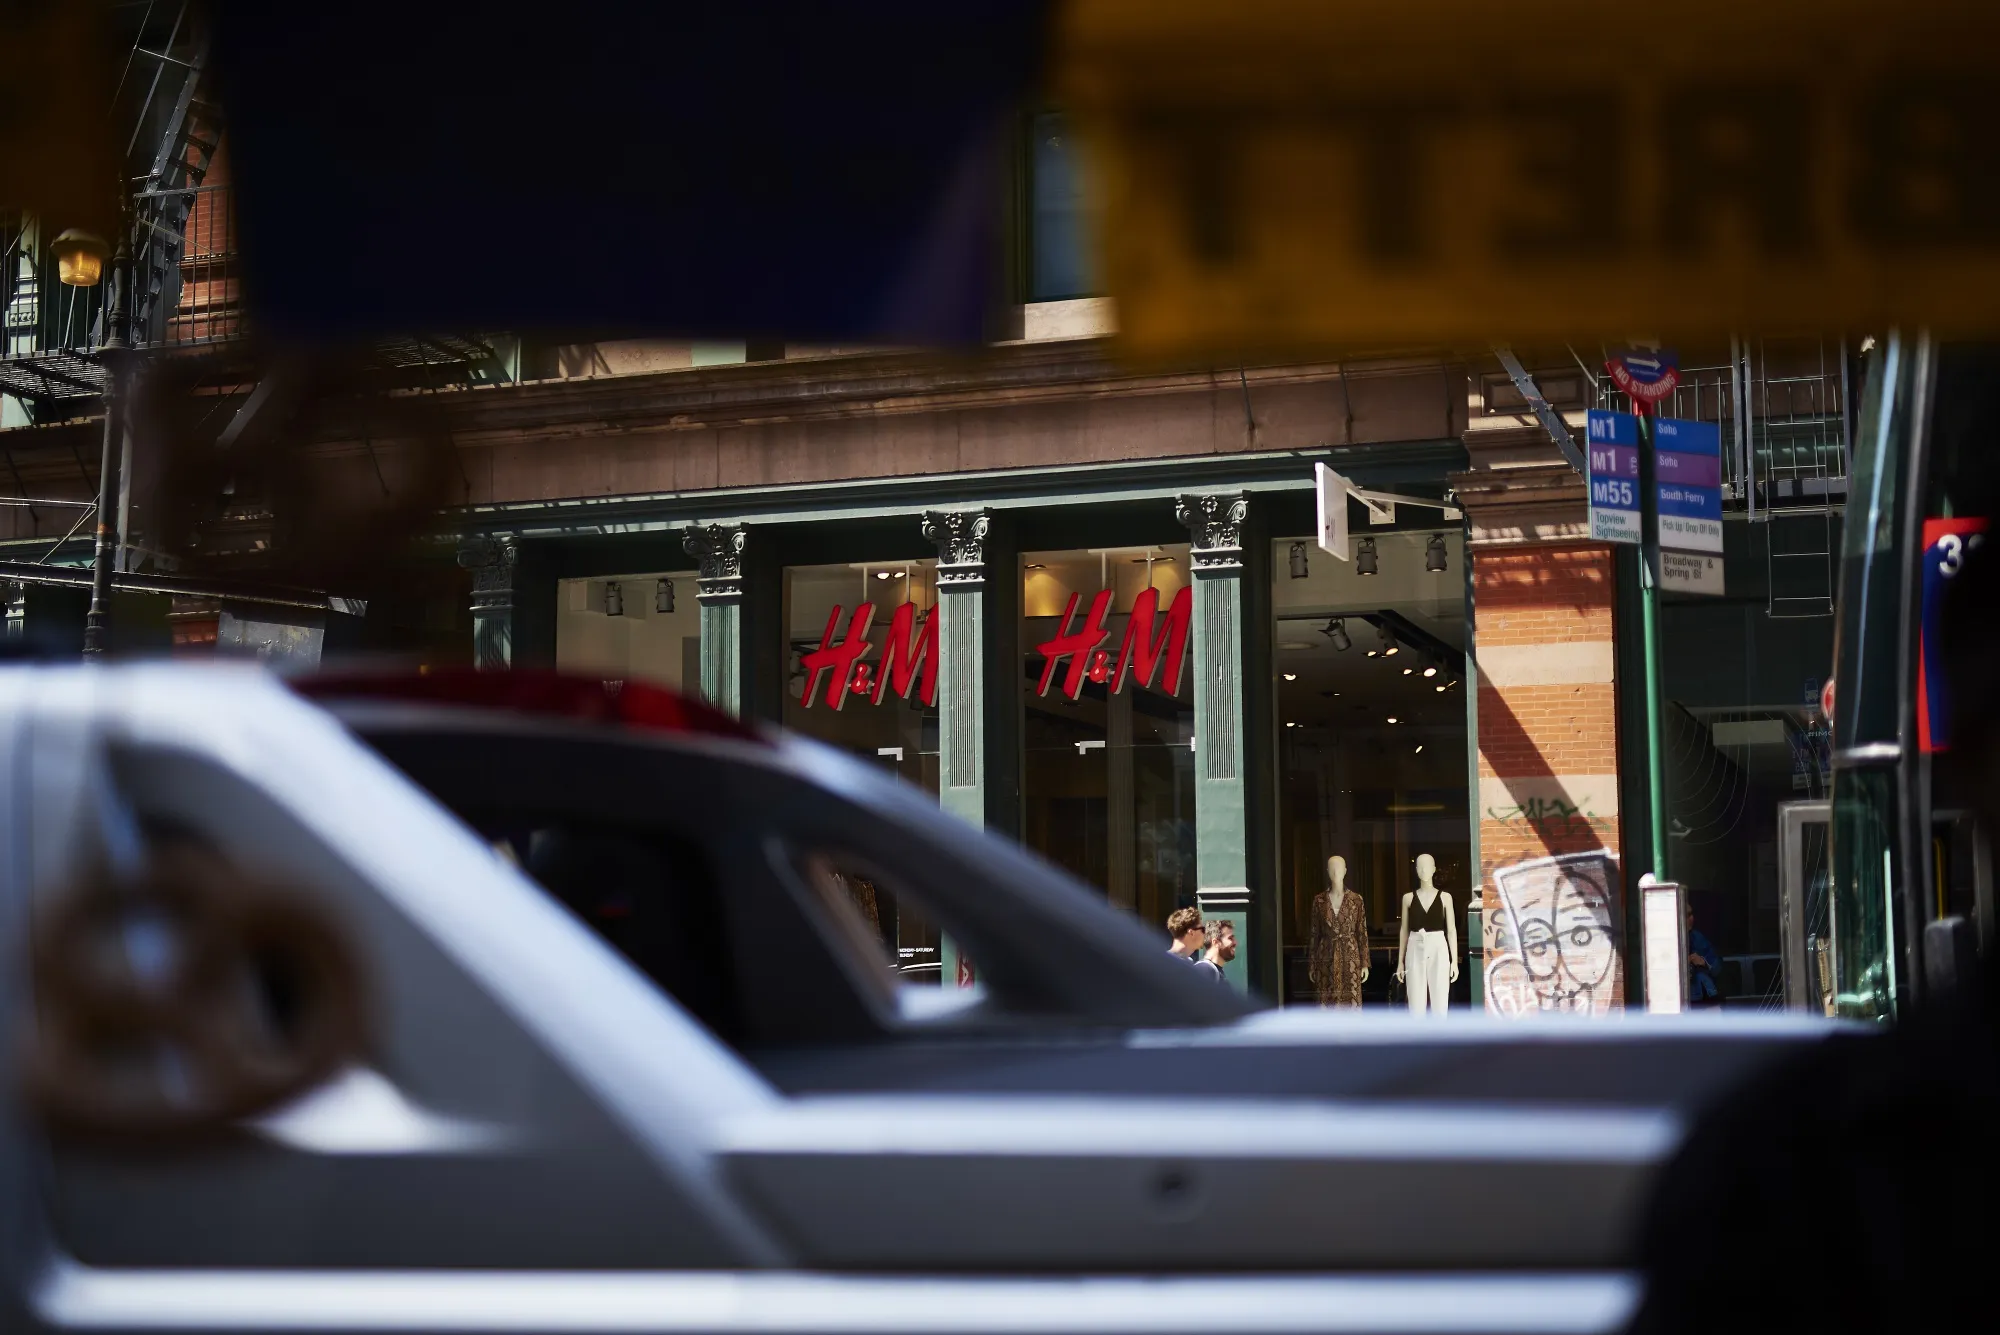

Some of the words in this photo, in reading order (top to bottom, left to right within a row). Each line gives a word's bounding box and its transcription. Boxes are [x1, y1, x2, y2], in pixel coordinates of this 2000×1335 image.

[1615, 366, 1630, 386] NO
[1631, 373, 1676, 396] STANDING
[1591, 416, 1616, 439] M1
[1657, 423, 1678, 436] Soho
[1592, 449, 1617, 472] M1
[1630, 456, 1638, 475] LTD
[1659, 455, 1679, 468] Soho
[1593, 478, 1633, 505] M55
[1660, 488, 1684, 501] South
[1685, 491, 1705, 505] Ferry
[1596, 512, 1627, 525] Topview
[1663, 519, 1674, 530] Pick
[1685, 522, 1699, 535] Drop
[1596, 526, 1640, 541] Sightseeing
[1663, 554, 1703, 569] Broadway
[1707, 559, 1714, 569] &
[1664, 566, 1690, 580] Spring
[1693, 569, 1703, 579] St
[1036, 585, 1193, 701] H&M
[800, 600, 939, 711] H&M
